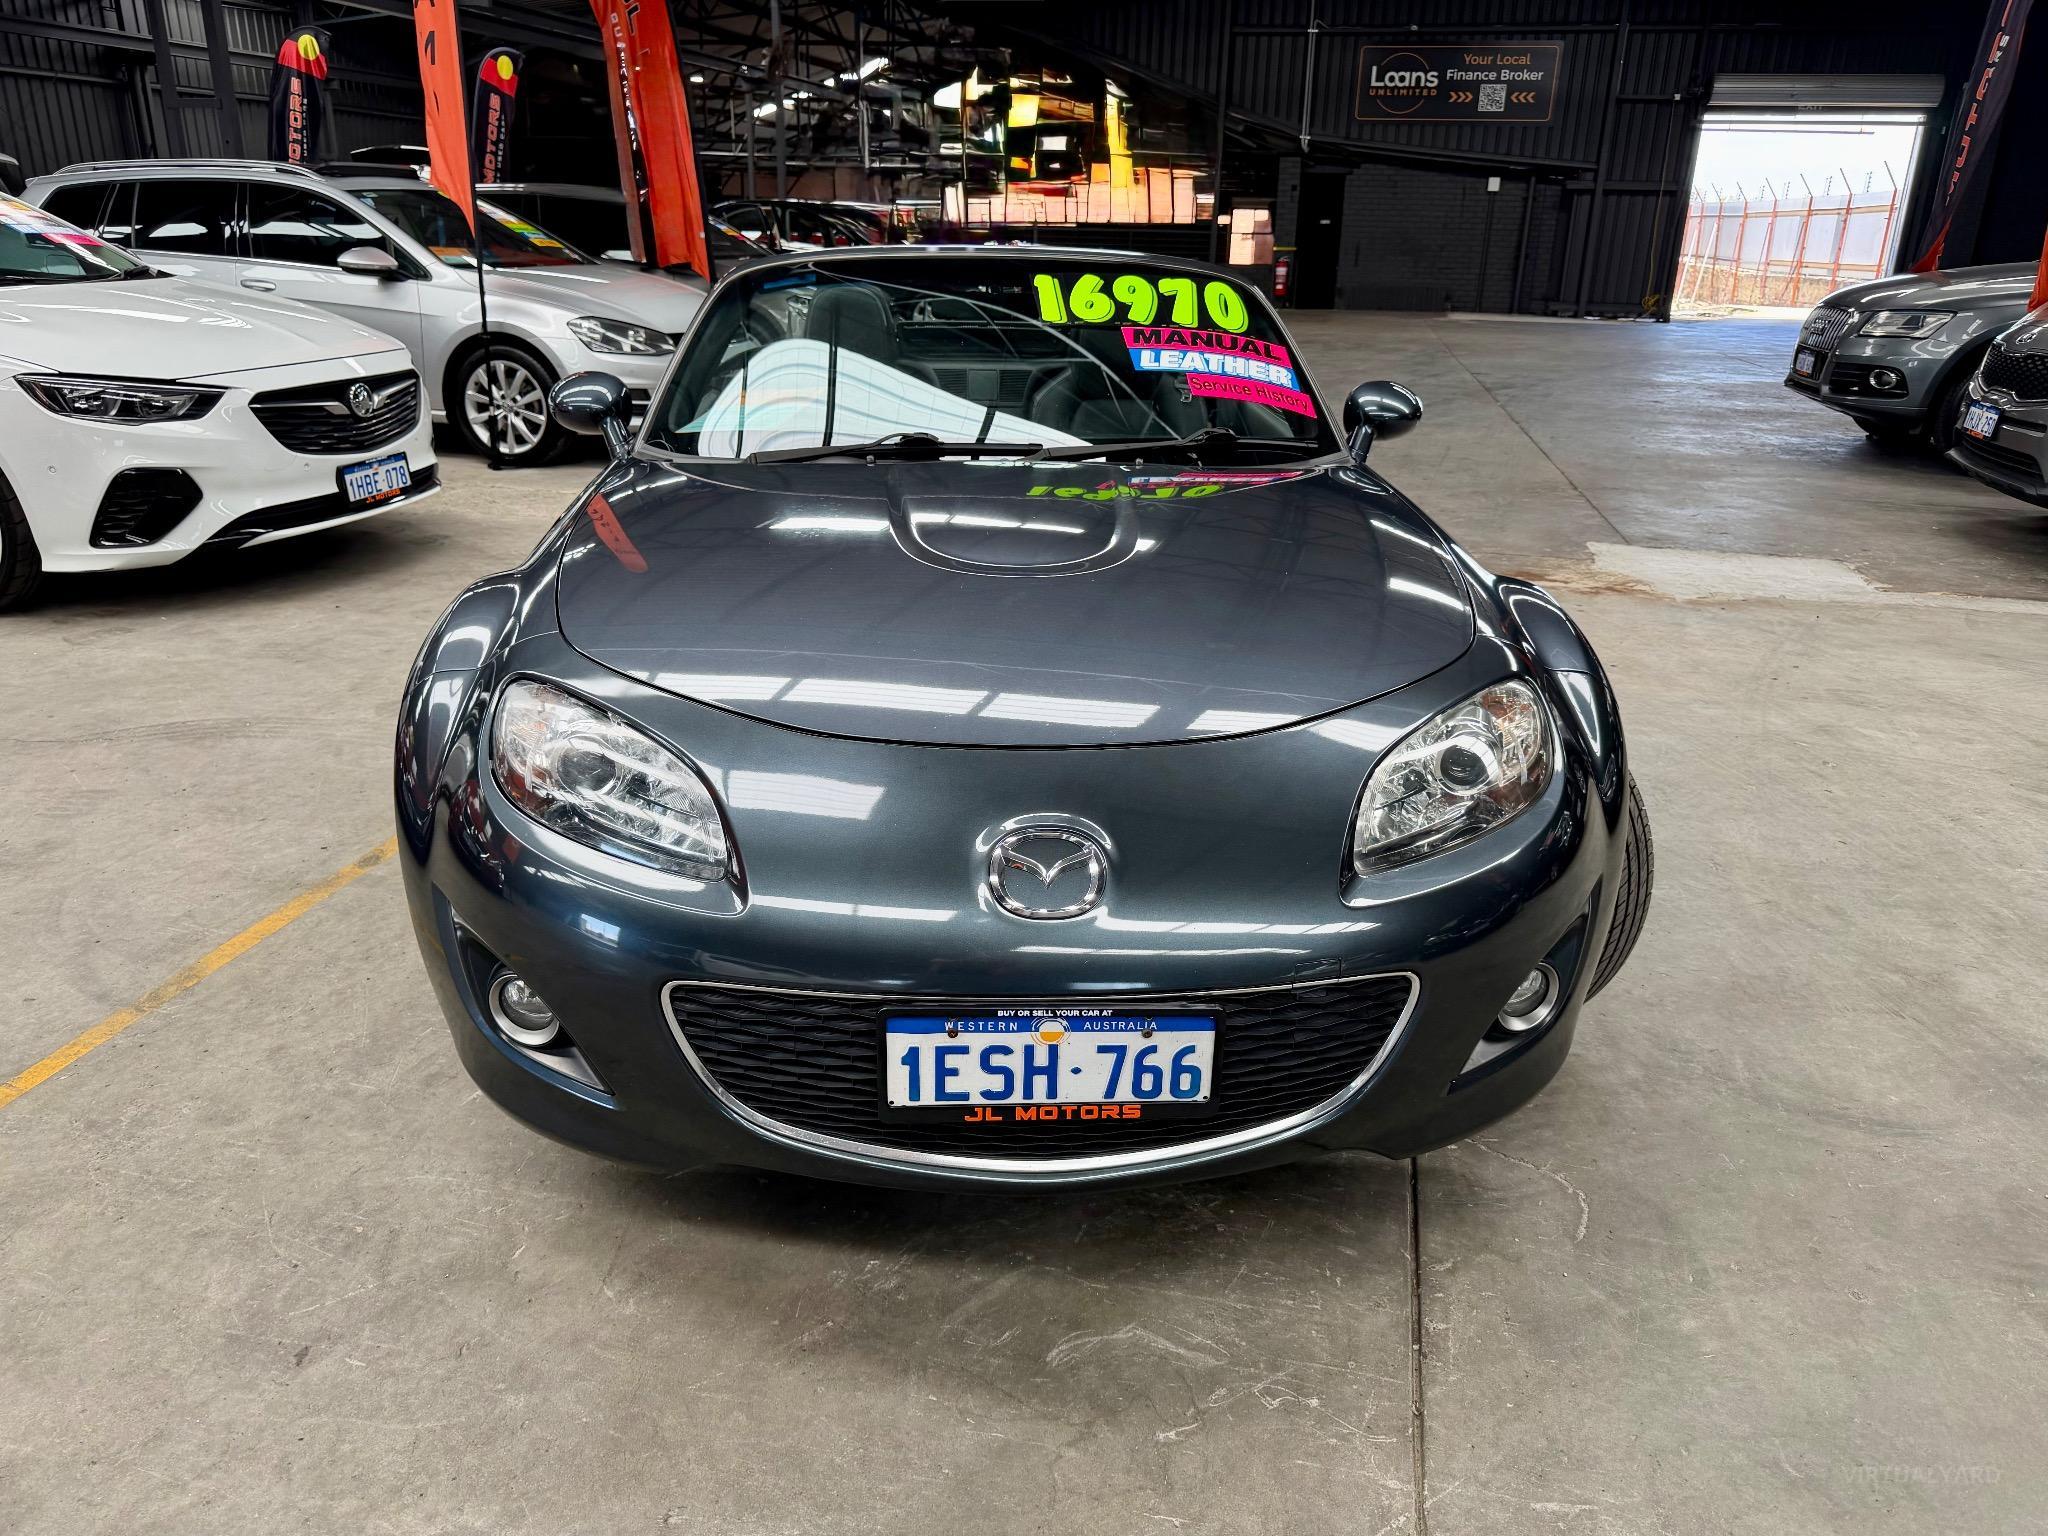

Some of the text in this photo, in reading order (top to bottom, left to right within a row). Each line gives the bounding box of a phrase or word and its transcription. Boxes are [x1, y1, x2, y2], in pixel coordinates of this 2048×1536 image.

[1463, 53, 1531, 65] Your Local
[1370, 65, 1439, 88] Loans
[1446, 69, 1544, 81] Finance Broker
[1369, 88, 1438, 96] UNLIMITED
[1033, 273, 1249, 334] 16970
[1133, 328, 1282, 362] MANUAL
[1139, 349, 1293, 388] LEATHER
[1190, 376, 1309, 411] Service History
[375, 489, 401, 499] MOTORS
[944, 1021, 1158, 1031] WESTERN AUSTRALIA
[964, 1105, 1142, 1121] JL MOTORS
